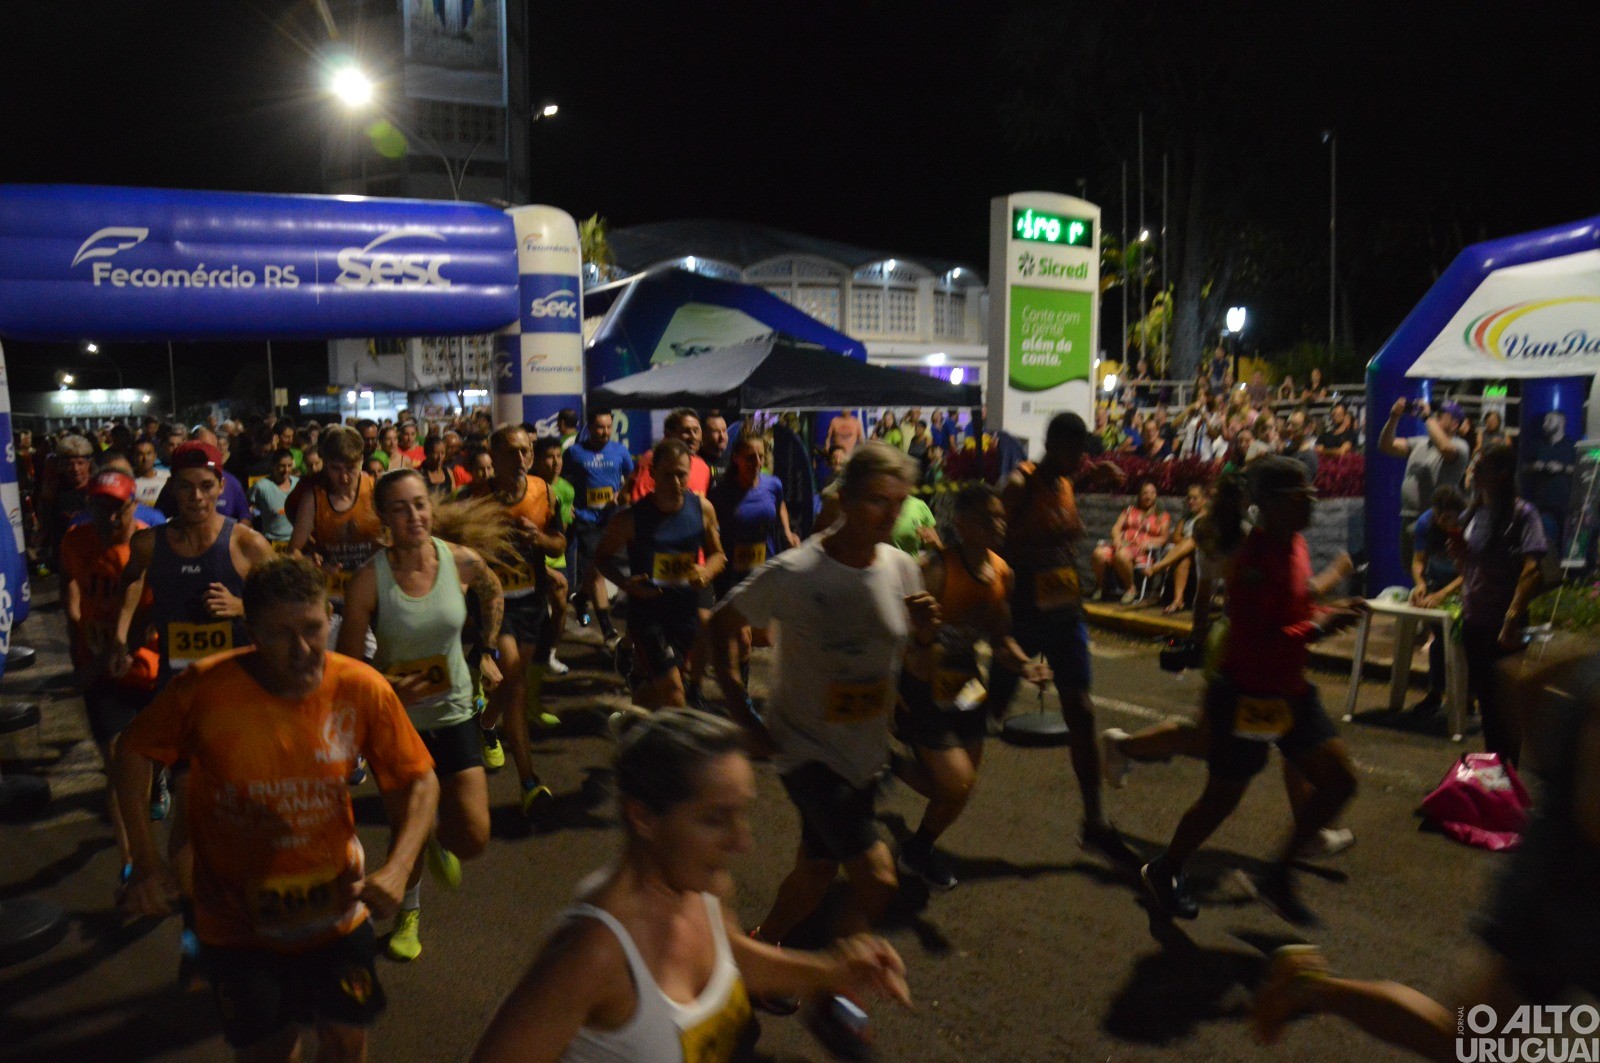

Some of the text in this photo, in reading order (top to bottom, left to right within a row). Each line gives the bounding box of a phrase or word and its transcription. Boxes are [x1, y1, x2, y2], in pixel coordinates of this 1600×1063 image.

[92, 262, 301, 289] Fecomércio RS
[335, 247, 454, 289] Sesc
[1038, 257, 1090, 280] Sicredi
[530, 297, 578, 319] Sesc
[1022, 335, 1073, 353] além da
[181, 564, 202, 574] FILA
[176, 630, 226, 650] 350
